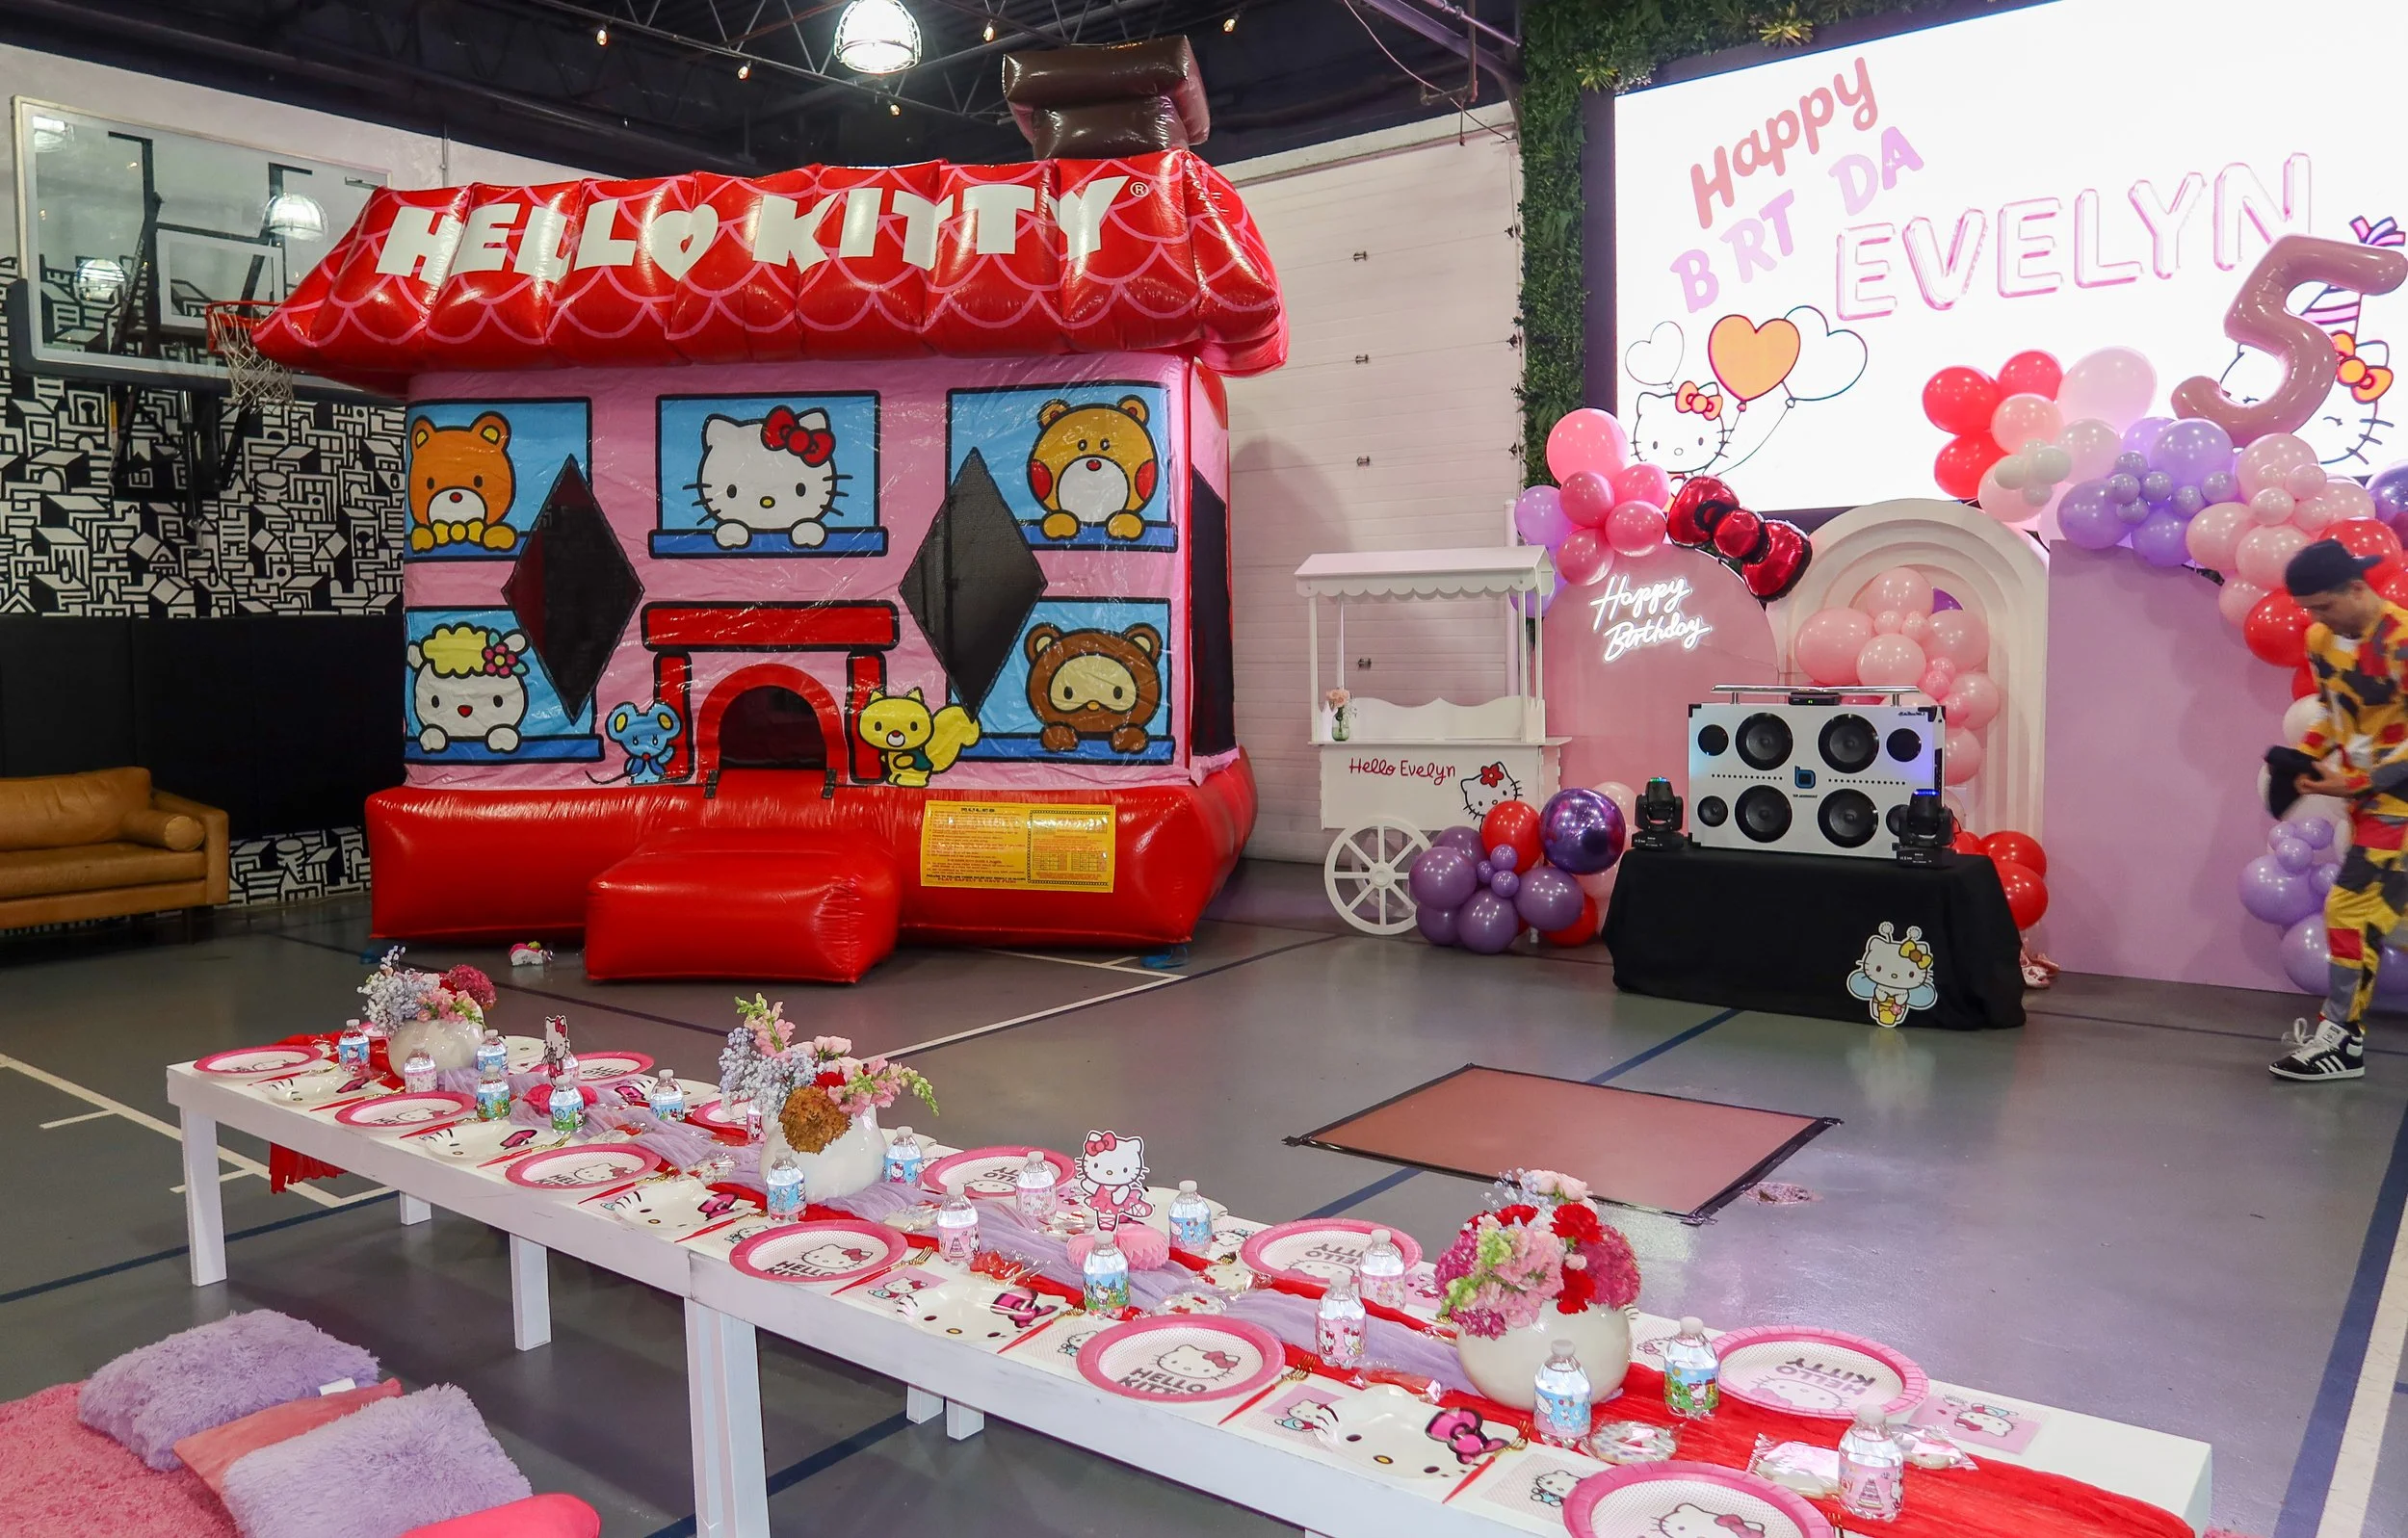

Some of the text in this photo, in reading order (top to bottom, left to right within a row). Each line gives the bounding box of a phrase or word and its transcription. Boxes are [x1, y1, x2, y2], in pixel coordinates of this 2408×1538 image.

[1690, 56, 1878, 229] Happy
[374, 197, 720, 287] HELLO
[1834, 151, 2312, 322] EVELYN
[1588, 574, 1693, 632] Happy
[1603, 610, 1714, 663] Birthday
[1348, 757, 1456, 786] Hello Evelyn
[1304, 1250, 1360, 1266] ELLO
[1313, 1243, 1365, 1258] ITTY
[1129, 1368, 1208, 1393] HELLO
[1775, 1365, 1867, 1395] HELLO
[1785, 1357, 1877, 1388] KITTY
